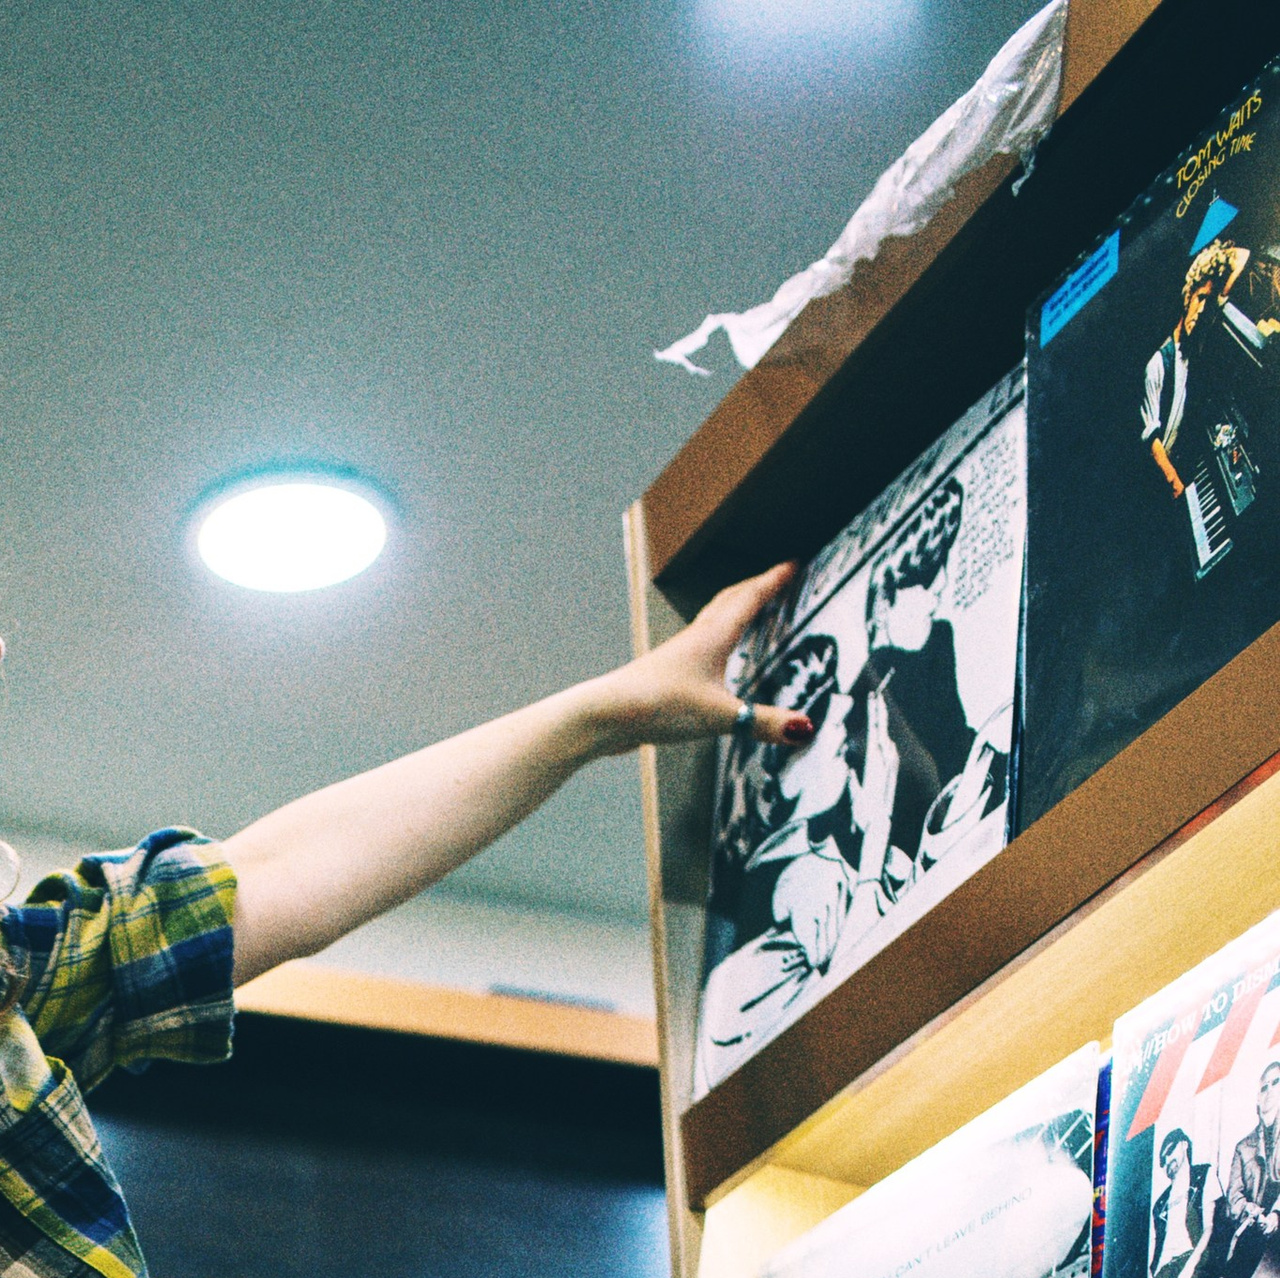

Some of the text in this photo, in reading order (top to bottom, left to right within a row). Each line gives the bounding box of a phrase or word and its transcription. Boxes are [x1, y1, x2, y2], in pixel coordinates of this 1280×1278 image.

[1176, 89, 1263, 188] TOM WAITS
[1176, 132, 1258, 218] CLOSING TIME
[1202, 991, 1229, 1022] TO
[935, 1222, 976, 1253] LEAVE
